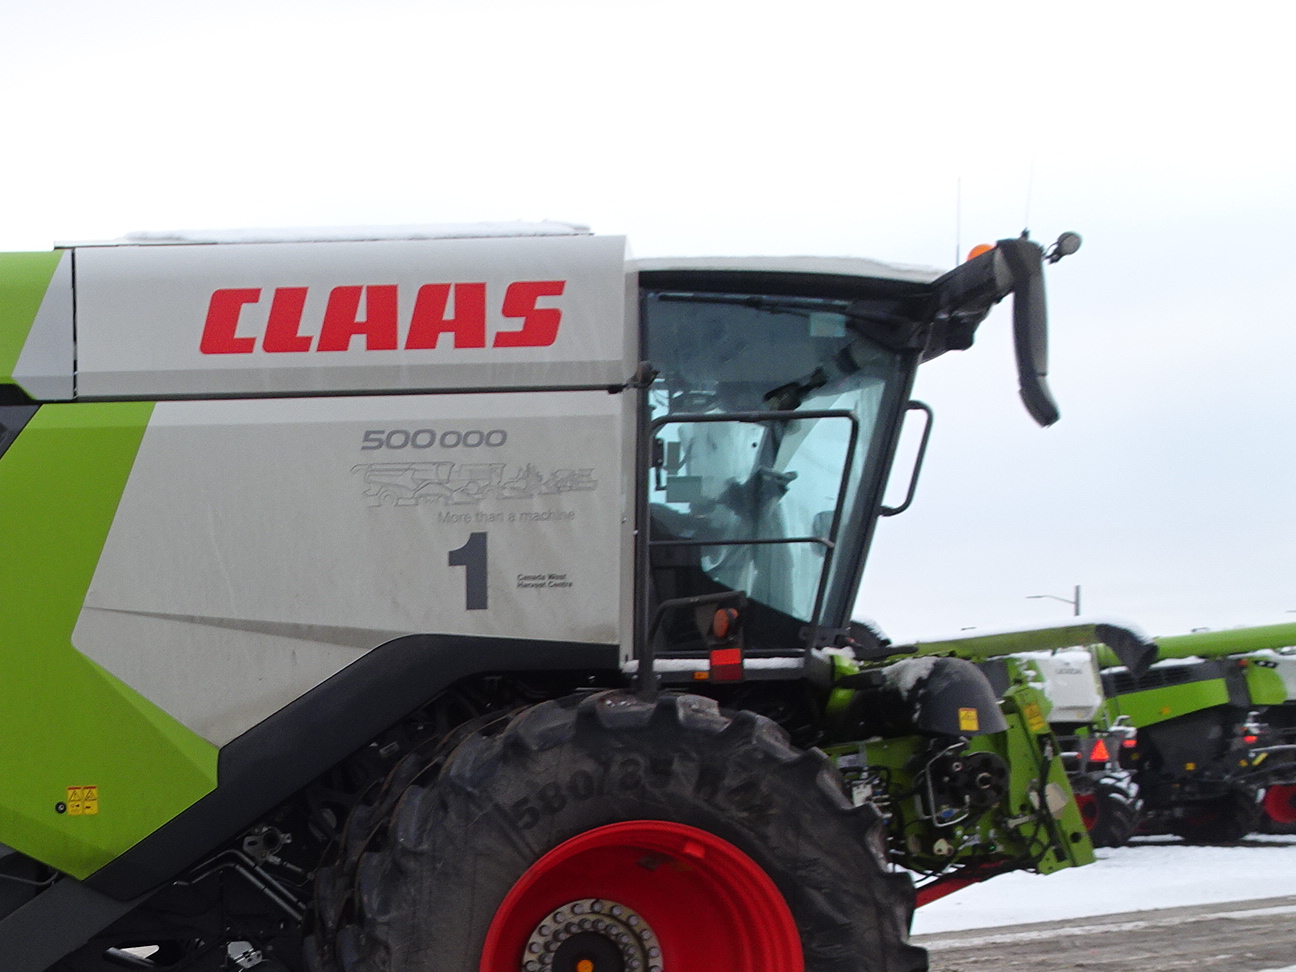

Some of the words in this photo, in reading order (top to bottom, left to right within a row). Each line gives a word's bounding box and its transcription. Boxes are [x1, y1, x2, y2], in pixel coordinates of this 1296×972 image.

[200, 279, 567, 355] CLAAS
[437, 510, 472, 525] More
[475, 510, 504, 524] than
[507, 512, 517, 523] a
[519, 508, 577, 523] machine
[448, 532, 488, 610] 1
